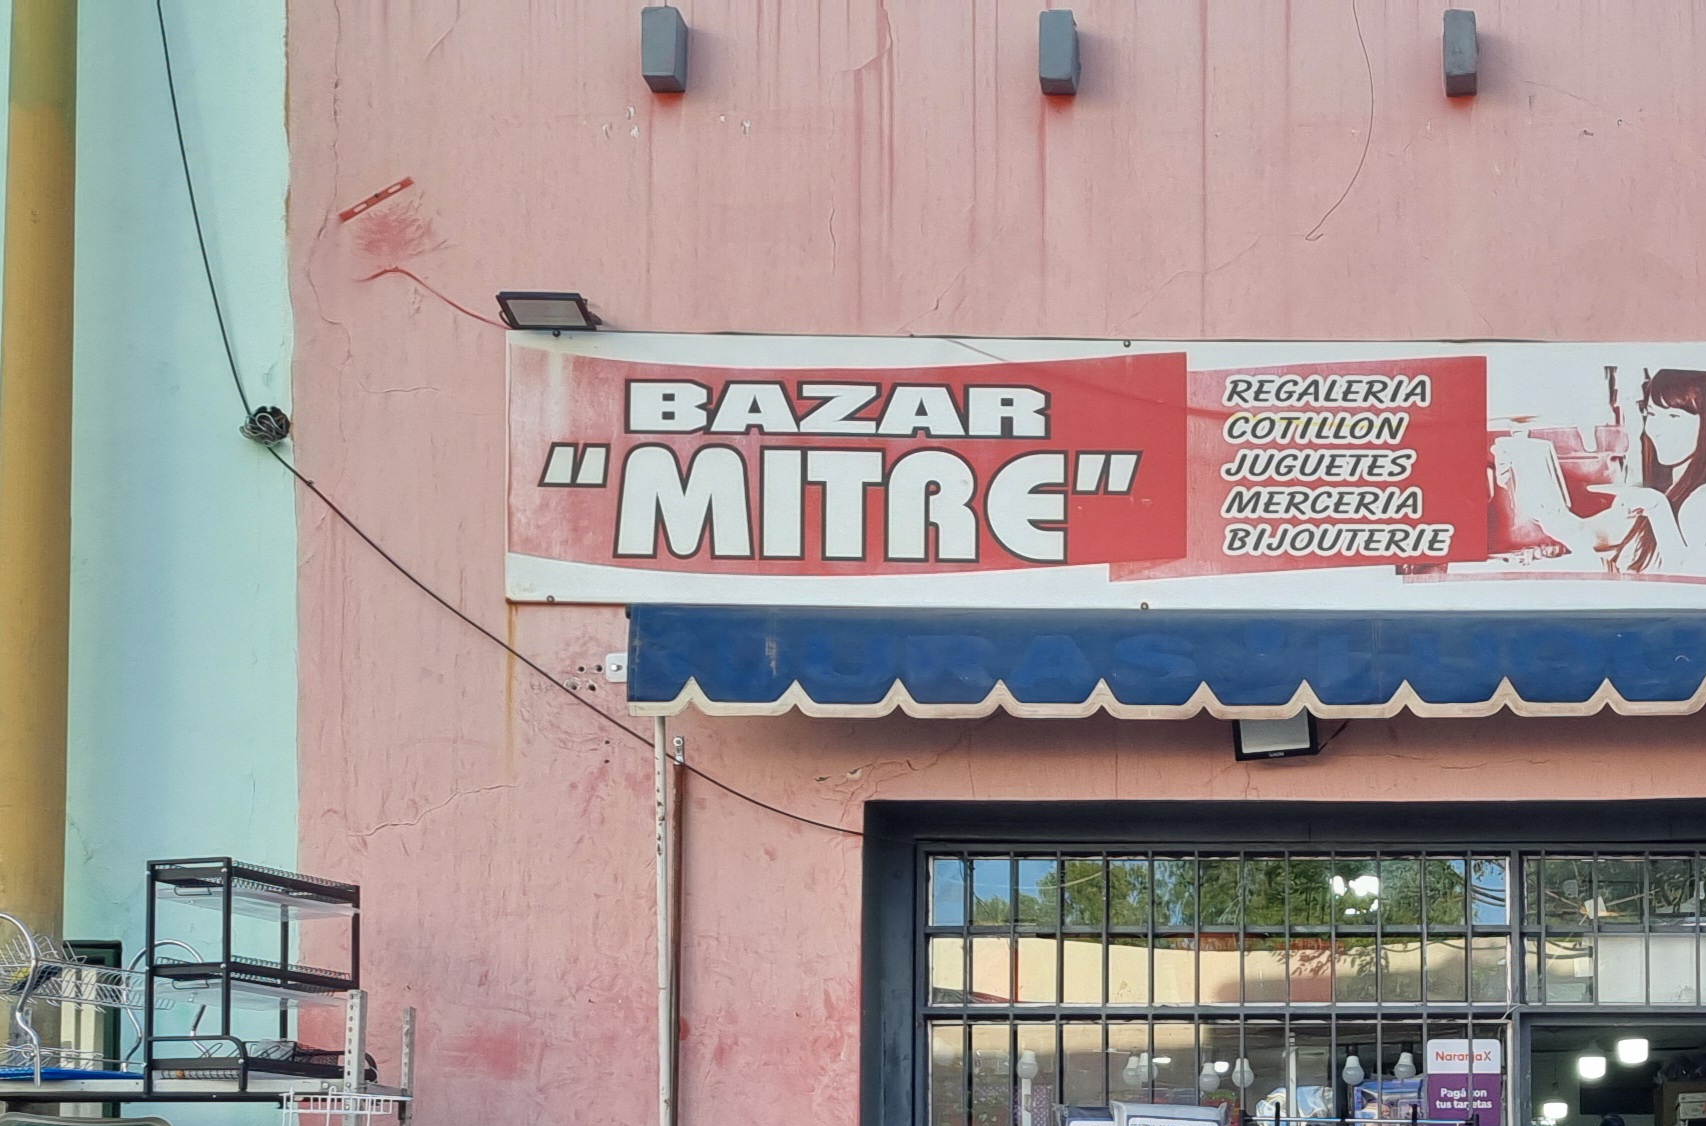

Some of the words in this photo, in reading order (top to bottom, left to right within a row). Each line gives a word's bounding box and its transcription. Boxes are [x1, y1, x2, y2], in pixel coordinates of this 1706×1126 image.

[1225, 377, 1430, 405] REGALERIA
[625, 378, 1051, 439] BAZAR
[1224, 414, 1404, 442] COTILLON
[1223, 452, 1413, 479] JUGUETES
[1223, 489, 1421, 517] MERCERIA
[1223, 526, 1450, 555] BIJOUTERIE
[1435, 1100, 1452, 1109] tus
[1453, 1100, 1493, 1111] taretas
[1440, 1088, 1467, 1100] Pagá
[1472, 1090, 1488, 1098] on
